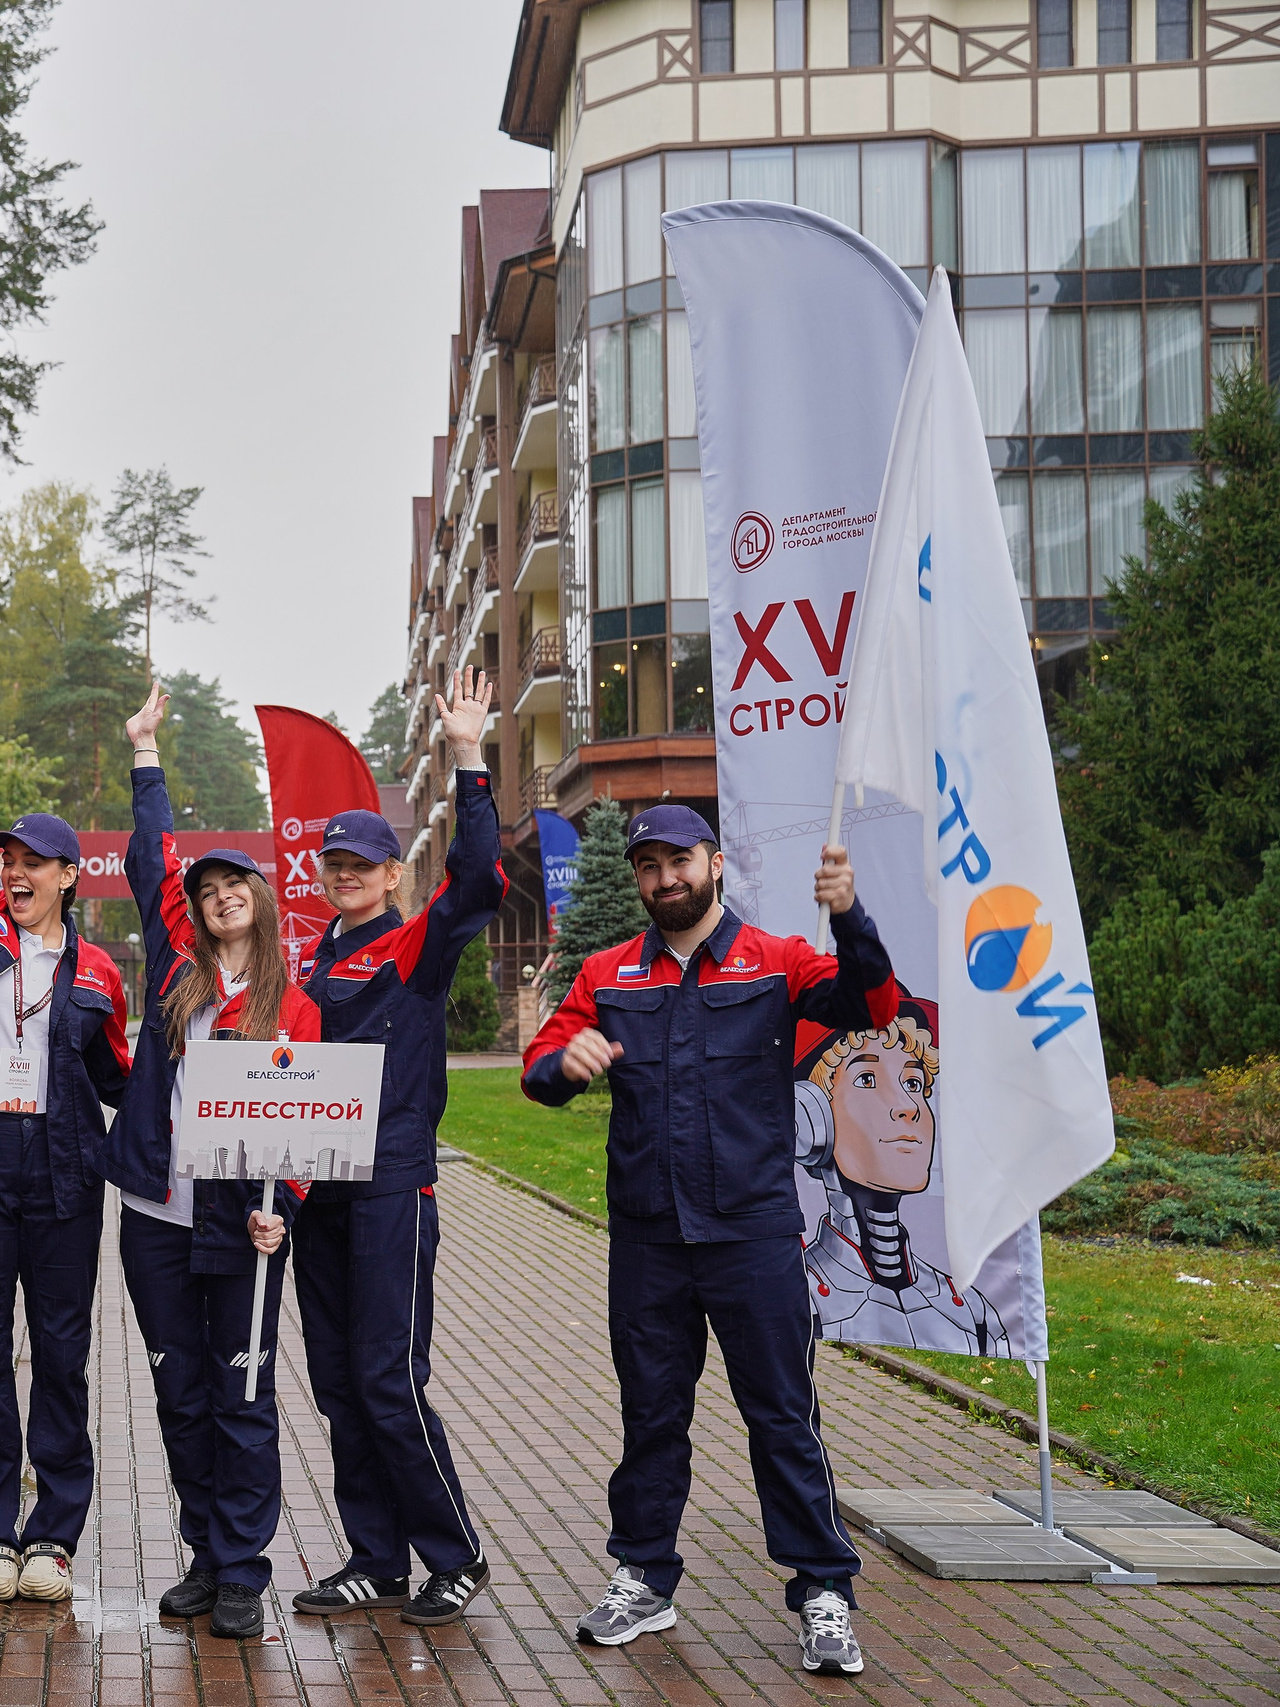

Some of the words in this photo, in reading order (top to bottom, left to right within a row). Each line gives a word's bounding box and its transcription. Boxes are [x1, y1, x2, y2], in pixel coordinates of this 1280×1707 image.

[782, 507, 846, 527] ДЕПАРТАМЕНТ
[783, 536, 824, 549] ГОРОДА
[826, 528, 864, 542] МОСКВЫ
[546, 866, 578, 882] XVIII
[9, 1061, 30, 1070] XVIII
[247, 1069, 315, 1080] ВЕЛЕССТРОЙ
[197, 1097, 363, 1121] ВЕЛЕССТРОЙ
